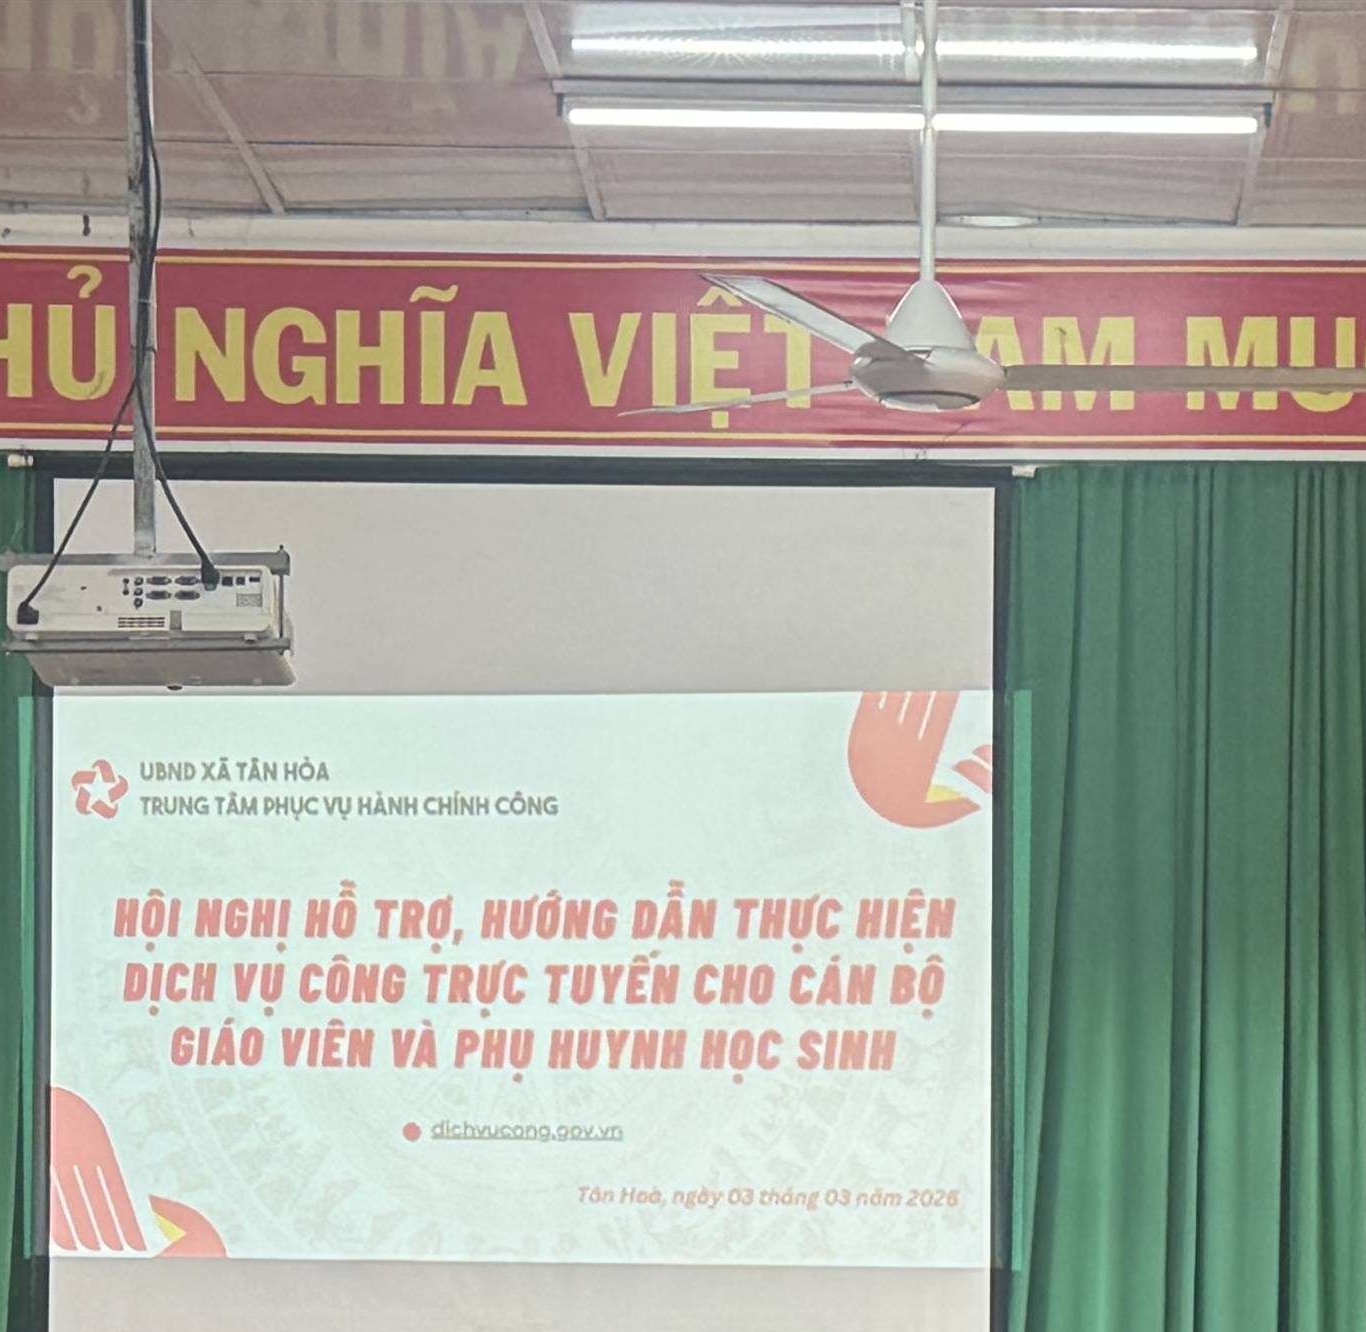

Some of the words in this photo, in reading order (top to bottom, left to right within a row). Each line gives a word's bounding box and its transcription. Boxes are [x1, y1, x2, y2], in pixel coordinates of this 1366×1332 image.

[175, 285, 528, 407] NGHĨA
[568, 286, 811, 428] VIỆT
[925, 316, 1135, 411] AM
[139, 761, 197, 782] UBND
[201, 756, 231, 782] XÃ
[236, 757, 278, 782] TÂN
[139, 796, 210, 816] TRUNG
[215, 791, 259, 816] TÂM
[263, 796, 320, 822] PHỤC
[323, 796, 354, 822] VỤ
[358, 790, 418, 816] HÀNH
[423, 790, 490, 816] CHÍNH
[494, 791, 560, 816] CÔNG
[113, 888, 182, 953] HỘI
[194, 897, 292, 954] NGHỊ
[303, 879, 358, 940] HỖ
[374, 894, 464, 954] TRỢ,
[481, 889, 618, 941] HƯỚNG
[631, 879, 719, 941] DẪN
[735, 893, 844, 954] THỰC
[855, 888, 957, 954] HIỆN
[123, 962, 218, 1017] DỊCH
[233, 962, 286, 1017] VỤ
[298, 954, 407, 1006] CÔNG
[423, 959, 528, 1019] TRỰC
[544, 949, 681, 1006] TUYẾN
[693, 963, 776, 1006] CHO
[788, 954, 877, 1007] CÁN
[889, 954, 946, 1019] BỘ
[170, 1016, 266, 1068] GIÁO
[282, 1018, 376, 1069] VIÊN
[390, 1018, 438, 1069] VÀ
[453, 1028, 535, 1084] PHỤ
[547, 1029, 689, 1072] HUYNH
[700, 1029, 784, 1085] HỌC
[797, 1029, 898, 1072] SINH
[727, 1187, 755, 1206] 03
[824, 1188, 852, 1207] 03
